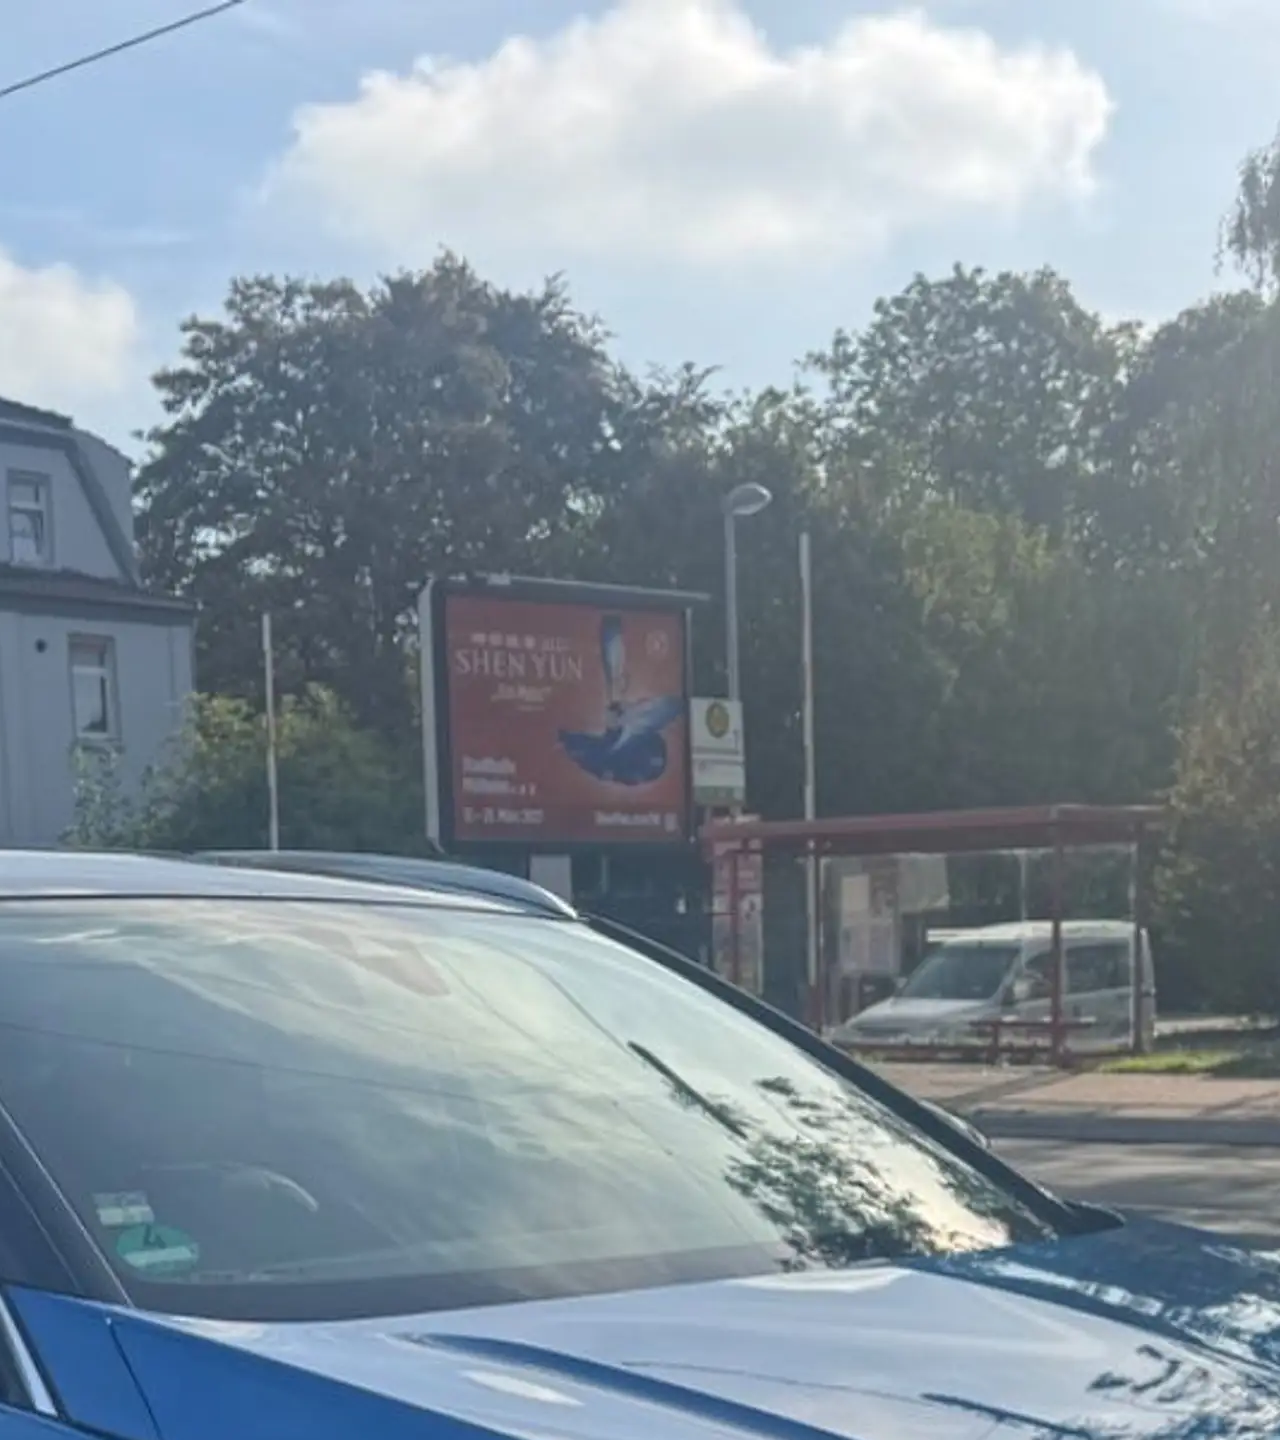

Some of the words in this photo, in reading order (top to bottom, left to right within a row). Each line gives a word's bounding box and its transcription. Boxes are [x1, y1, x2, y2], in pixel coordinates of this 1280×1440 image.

[455, 649, 525, 679] SHEN
[531, 652, 583, 680] YUN
[143, 1224, 167, 1250] 4
